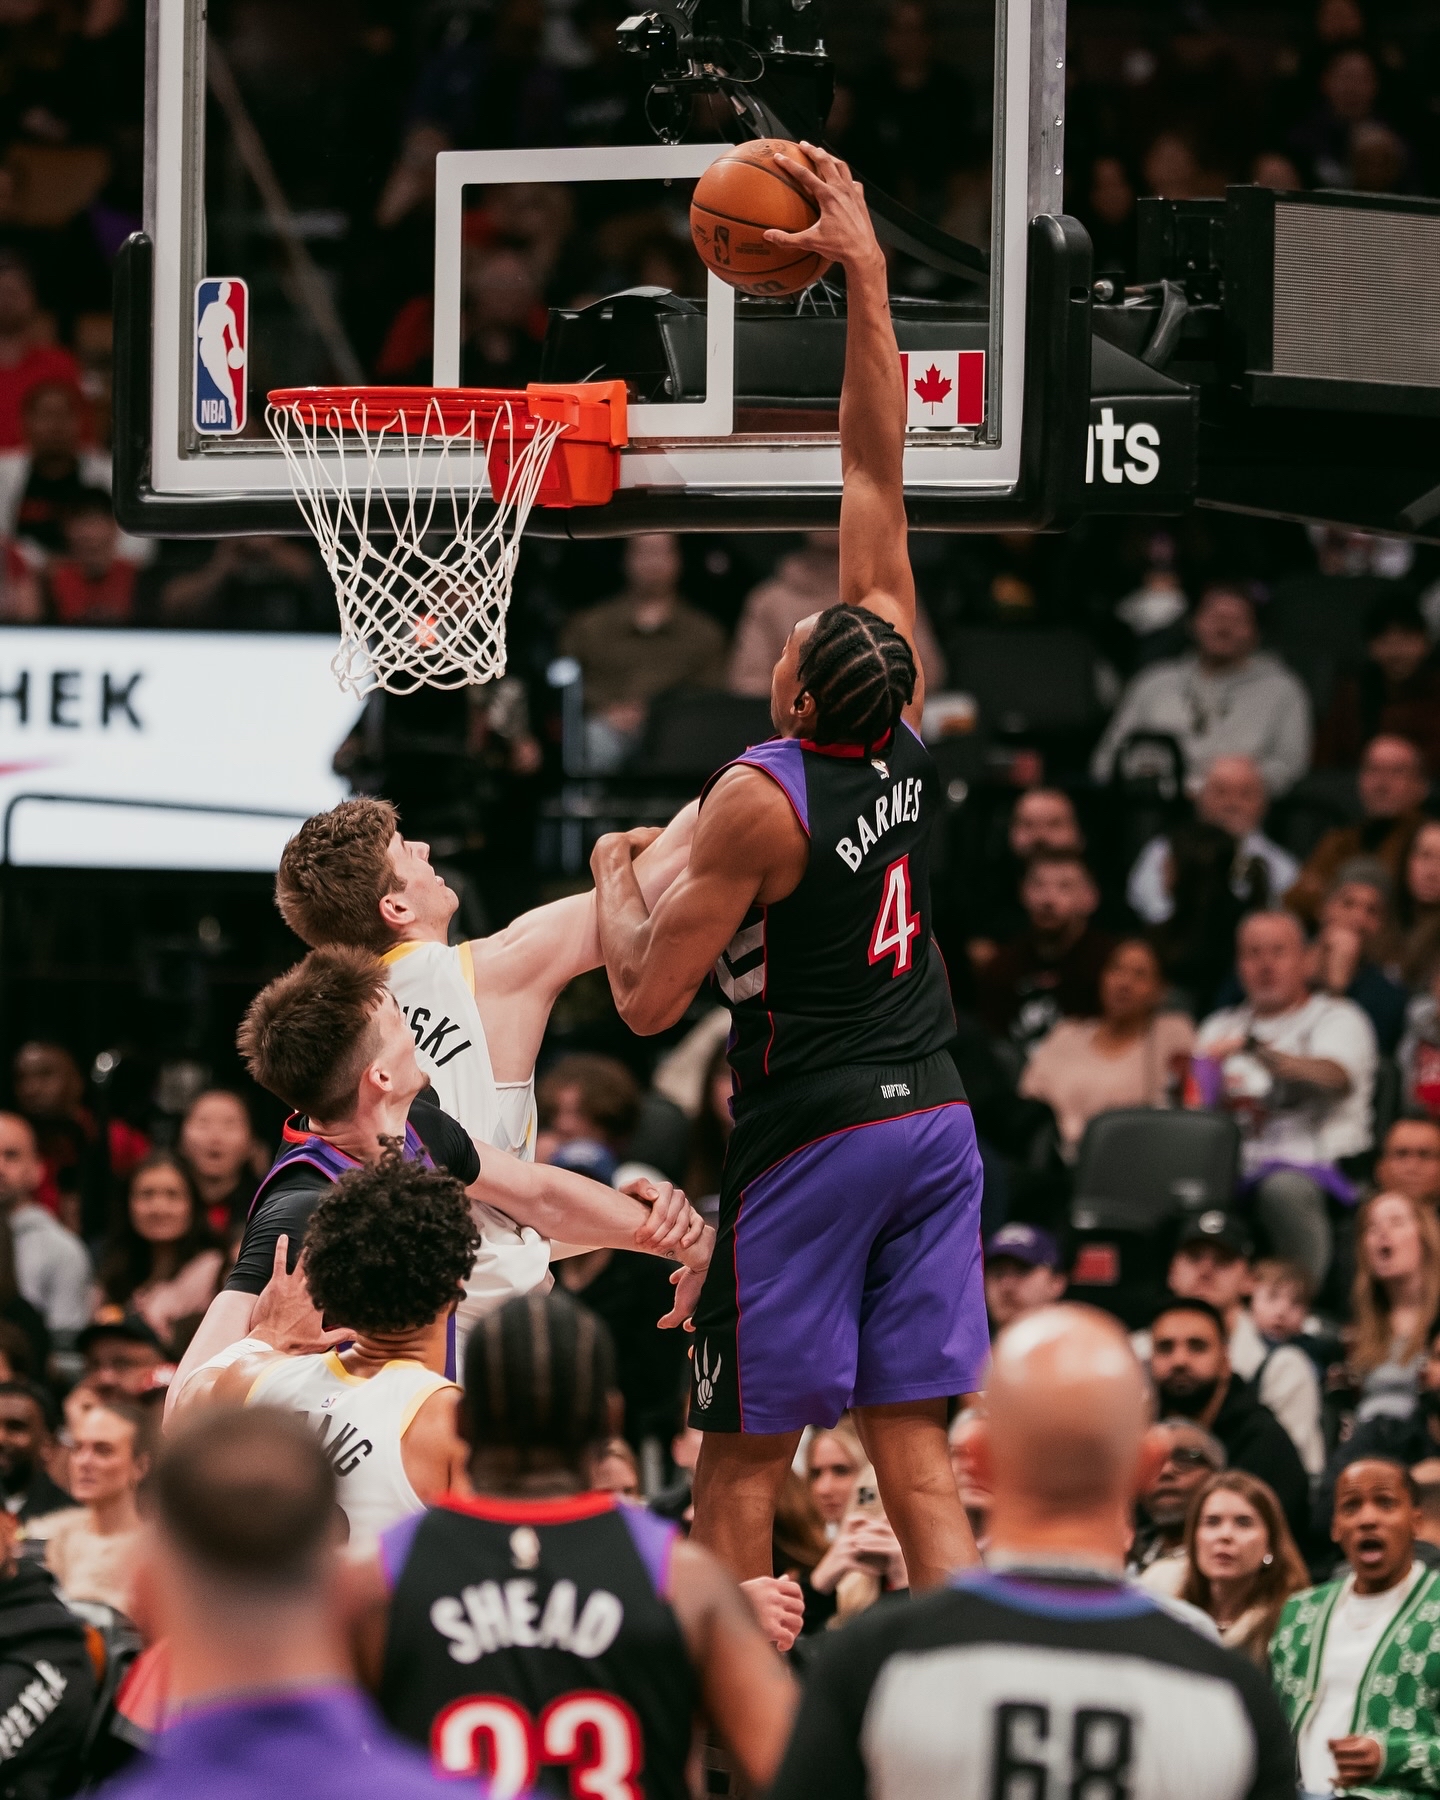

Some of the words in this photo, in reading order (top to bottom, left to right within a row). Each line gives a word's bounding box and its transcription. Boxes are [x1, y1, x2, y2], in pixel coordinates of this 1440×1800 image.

[201, 400, 226, 424] NBA
[835, 777, 922, 873] BARNES
[868, 854, 921, 978] 4
[403, 1006, 472, 1067] SKI
[430, 1578, 624, 1664] SHEAD
[993, 1702, 1133, 1800] 68
